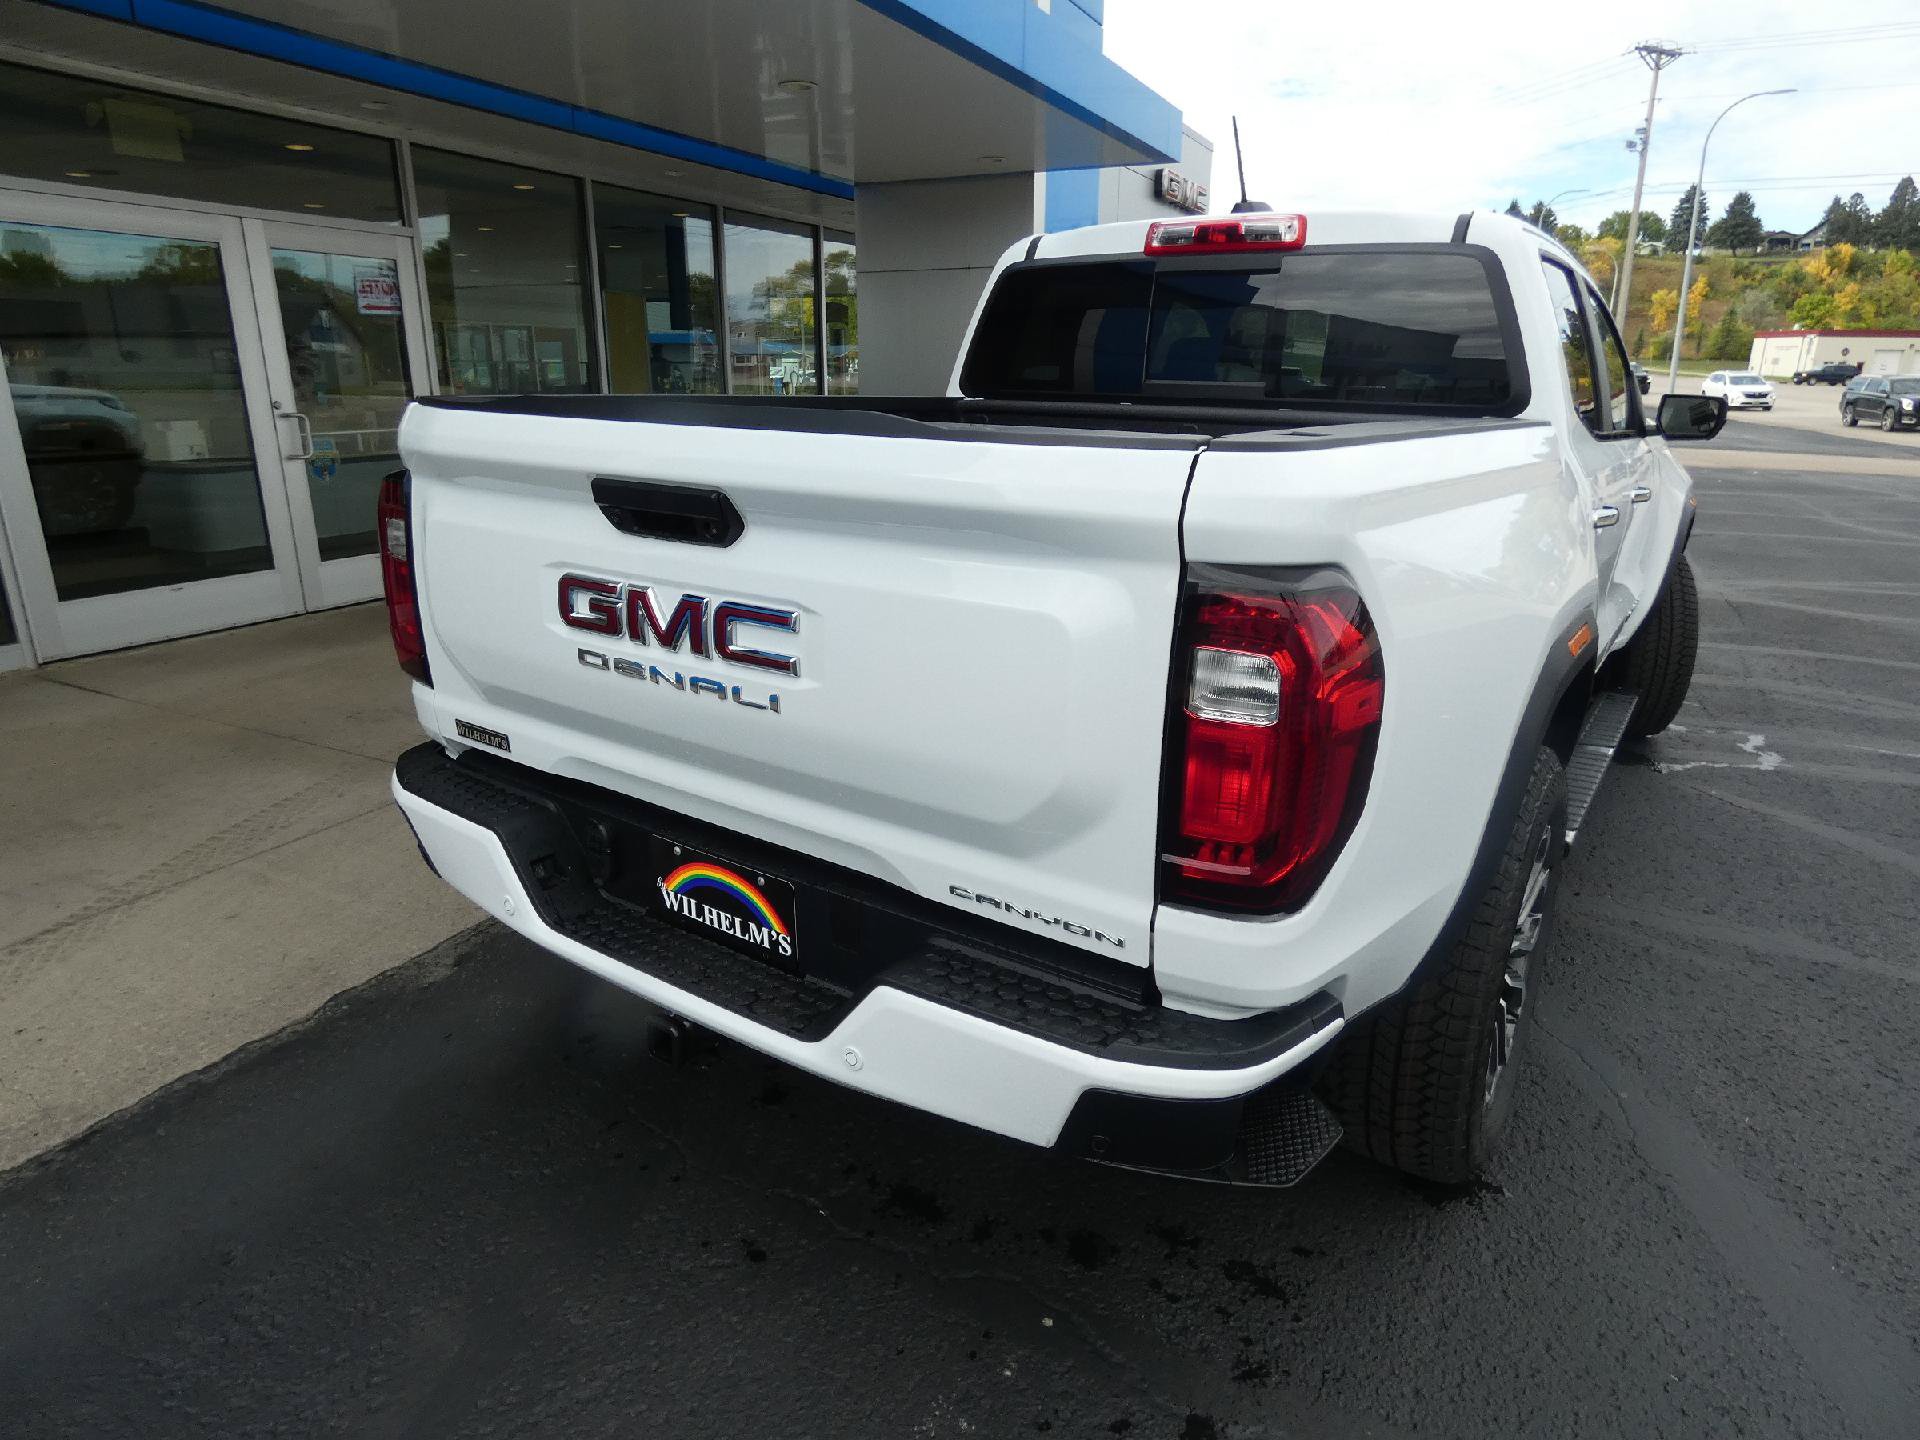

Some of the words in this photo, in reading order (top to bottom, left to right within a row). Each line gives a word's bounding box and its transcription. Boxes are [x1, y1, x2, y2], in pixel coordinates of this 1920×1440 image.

[1161, 168, 1207, 215] GMC
[557, 571, 801, 678] GMC
[577, 647, 782, 715] DENALI
[661, 886, 792, 957] WILHELM'S
[948, 885, 1126, 949] CANYON
